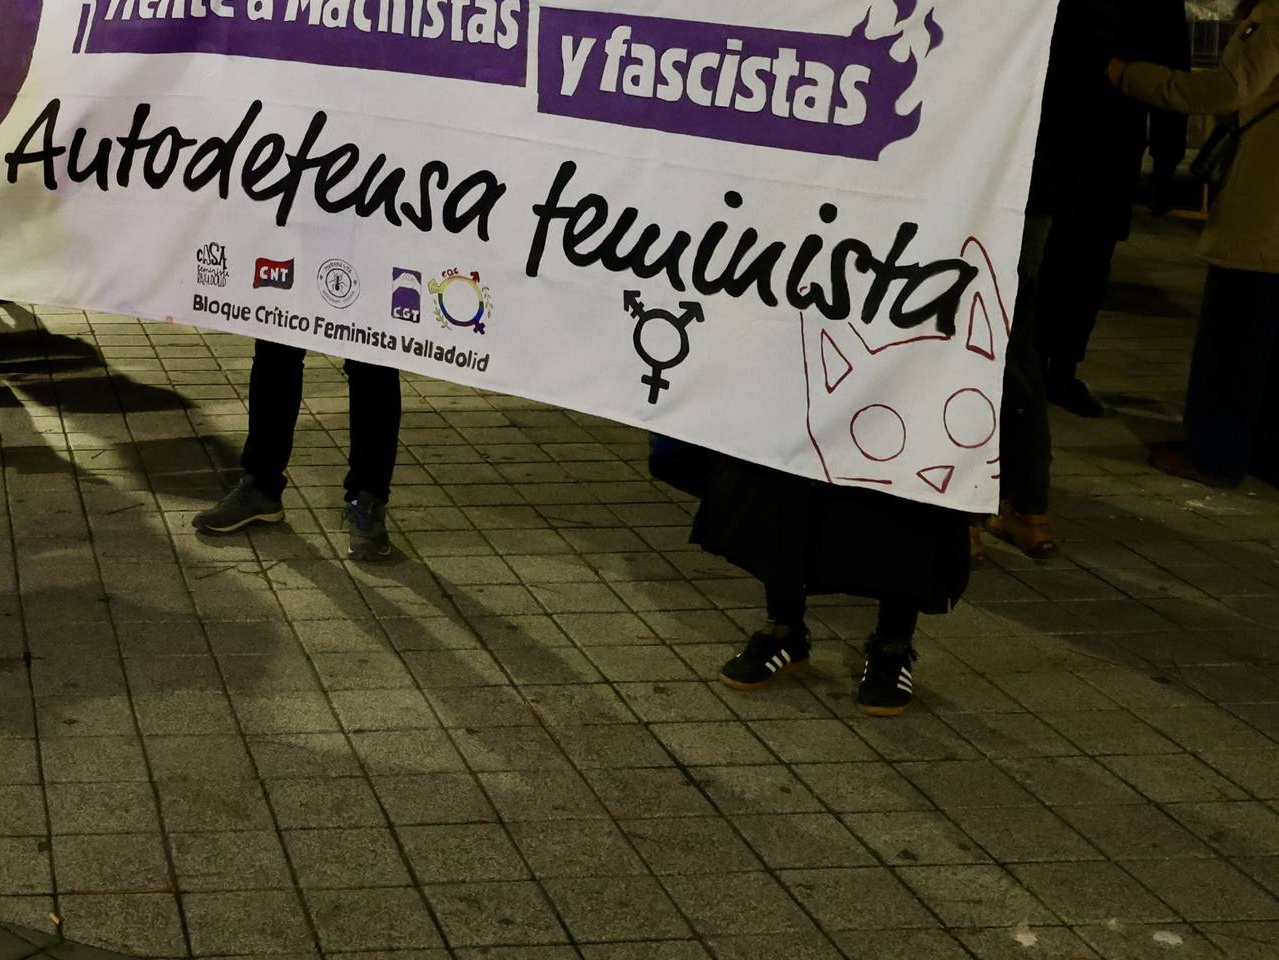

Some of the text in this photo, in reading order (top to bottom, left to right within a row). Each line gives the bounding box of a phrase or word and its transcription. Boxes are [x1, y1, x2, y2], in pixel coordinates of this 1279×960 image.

[560, 24, 871, 127] y fascistas
[5, 99, 978, 337] Autodefensa feminista
[259, 265, 289, 282] CNT
[193, 294, 489, 372] Bloque Crítico Feminista Valladolid
[393, 306, 420, 322] CGT
